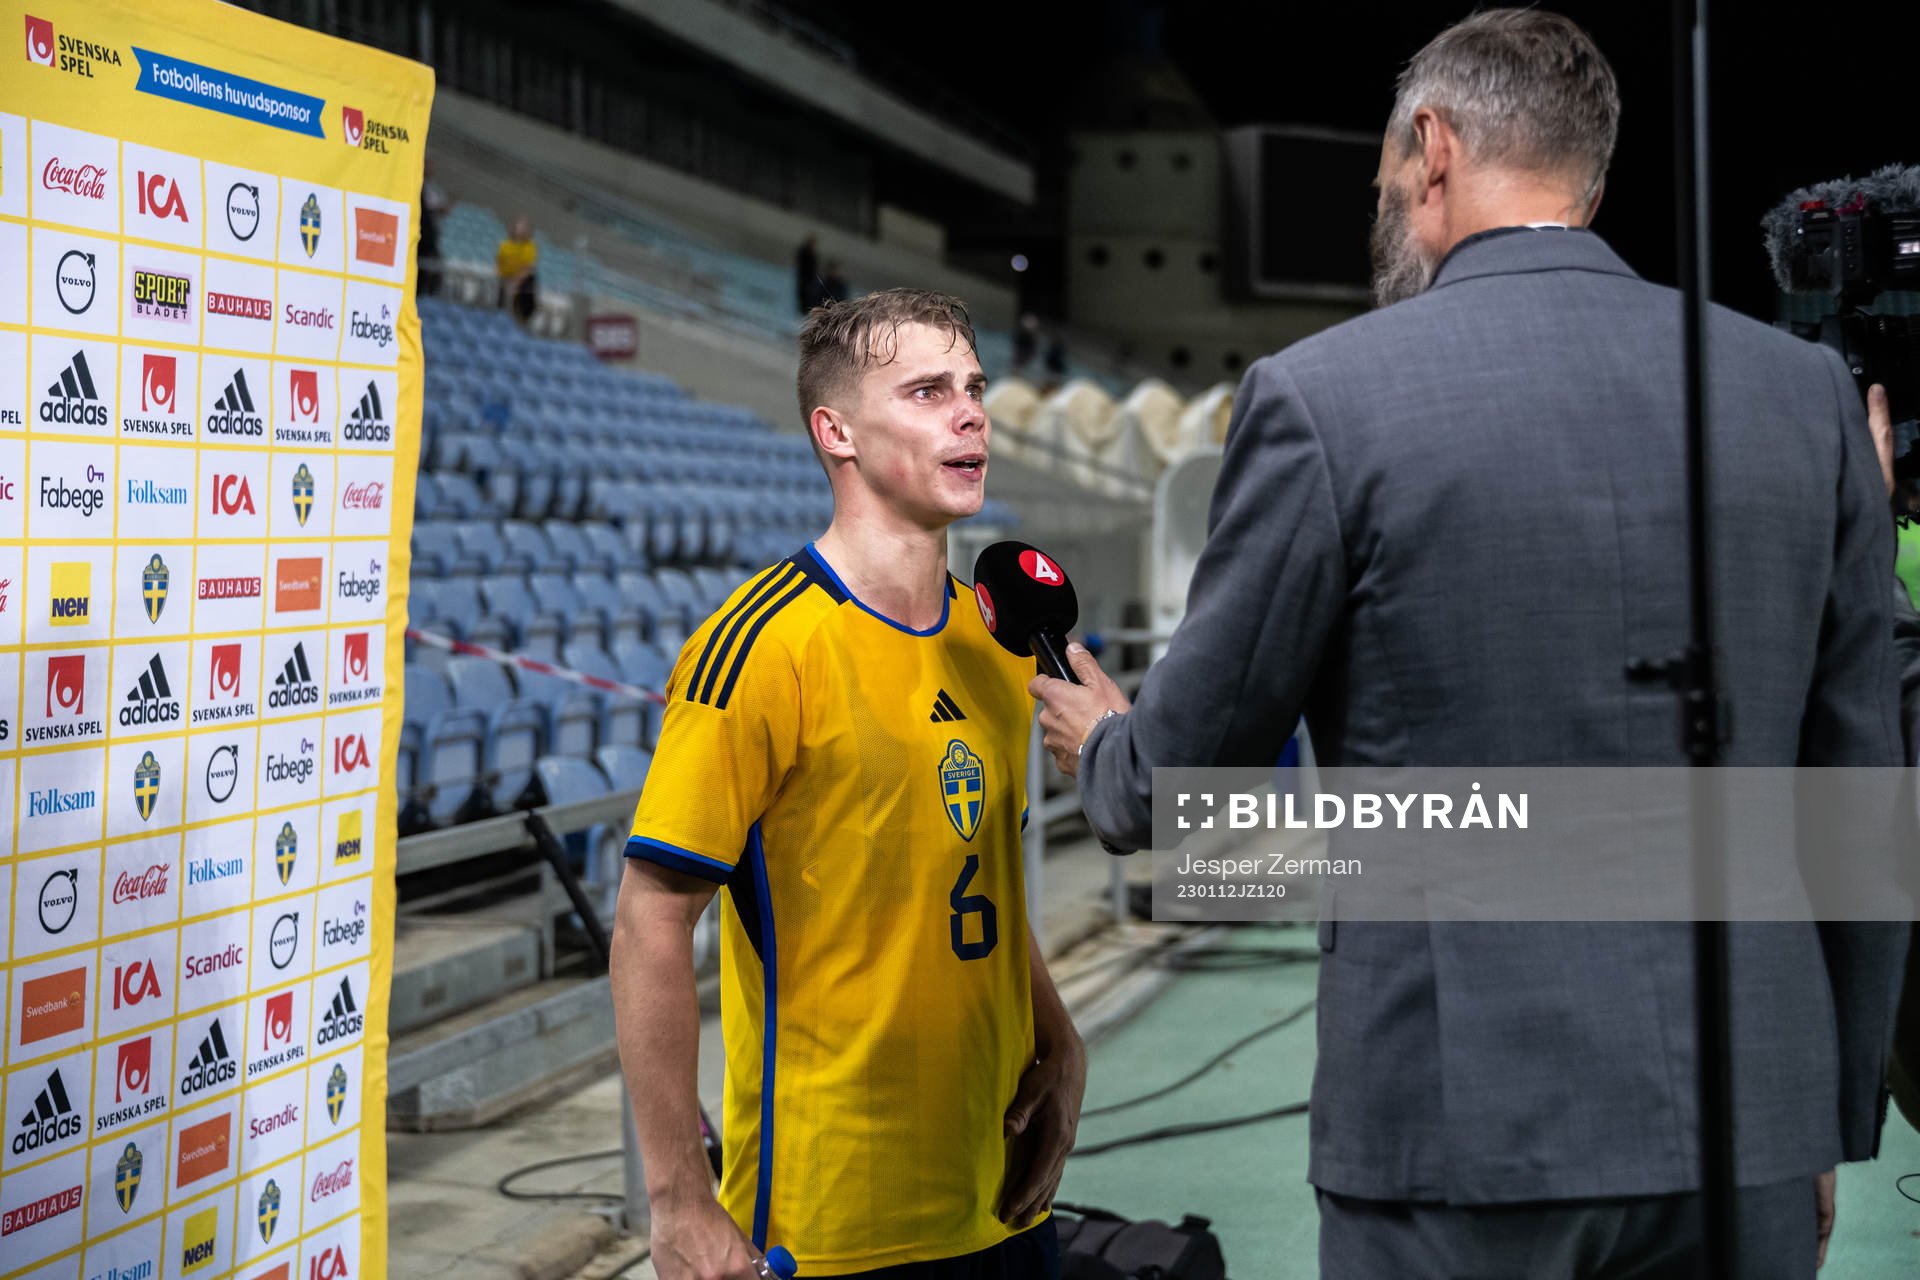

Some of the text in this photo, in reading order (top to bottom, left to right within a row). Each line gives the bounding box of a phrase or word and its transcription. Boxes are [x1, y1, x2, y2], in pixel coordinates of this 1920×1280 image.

[59, 34, 121, 66] SVENSKA
[60, 55, 94, 78] SPEL
[153, 63, 311, 123] Fotbollens huvudsponsor
[364, 135, 388, 154] SPEL
[366, 119, 409, 143] SVENSKA
[138, 171, 189, 223] ICA
[231, 206, 256, 217] VOLVO
[62, 277, 91, 287] VOLVO
[134, 271, 190, 304] SPORT
[137, 305, 187, 319] BLADET
[209, 294, 271, 318] BAUHAUS
[286, 303, 333, 329] Scandic
[351, 310, 392, 347] Fabege
[40, 397, 107, 426] adidas
[208, 411, 262, 436] adidas
[124, 419, 192, 435] SVENSKA SPEL
[276, 429, 331, 442] SVENSKA SPEL
[344, 419, 390, 442] adidas
[41, 476, 103, 517] Fabege
[128, 480, 187, 505] Folksam
[213, 474, 256, 516] ICA
[1035, 551, 1058, 582] 4
[200, 578, 260, 598] BAUHAUS
[339, 572, 380, 602] Fabege
[975, 585, 993, 628] 4
[269, 681, 318, 708] adidas
[329, 687, 380, 704] SVENSKA SPEL
[120, 698, 179, 726] adidas
[193, 704, 255, 722] SVENSKA SPEL
[25, 724, 75, 742] SVENSKA
[78, 721, 102, 736] SPEL
[335, 733, 370, 774] ICA
[210, 768, 234, 779] VOLVO
[267, 755, 313, 784] Fabege
[948, 769, 976, 779] SVERIGE
[28, 788, 95, 817] Folksam
[188, 857, 243, 885] Folksam
[44, 896, 73, 908] VOLVO
[950, 855, 998, 961] 6
[323, 918, 364, 947] Fabege
[186, 946, 243, 979] Scandic
[113, 958, 161, 1010] ICA
[26, 996, 69, 1018] Swedbank
[317, 1013, 363, 1045] adidas
[248, 1046, 304, 1076] SVENSKA SPEL
[181, 1059, 236, 1095] adidas
[97, 1096, 166, 1131] SVENSKA SPEL
[250, 1104, 298, 1139] Scandic
[13, 1112, 81, 1155] adidas
[182, 1141, 216, 1163] Swedbank
[3, 1186, 81, 1235] BAUHAUS
